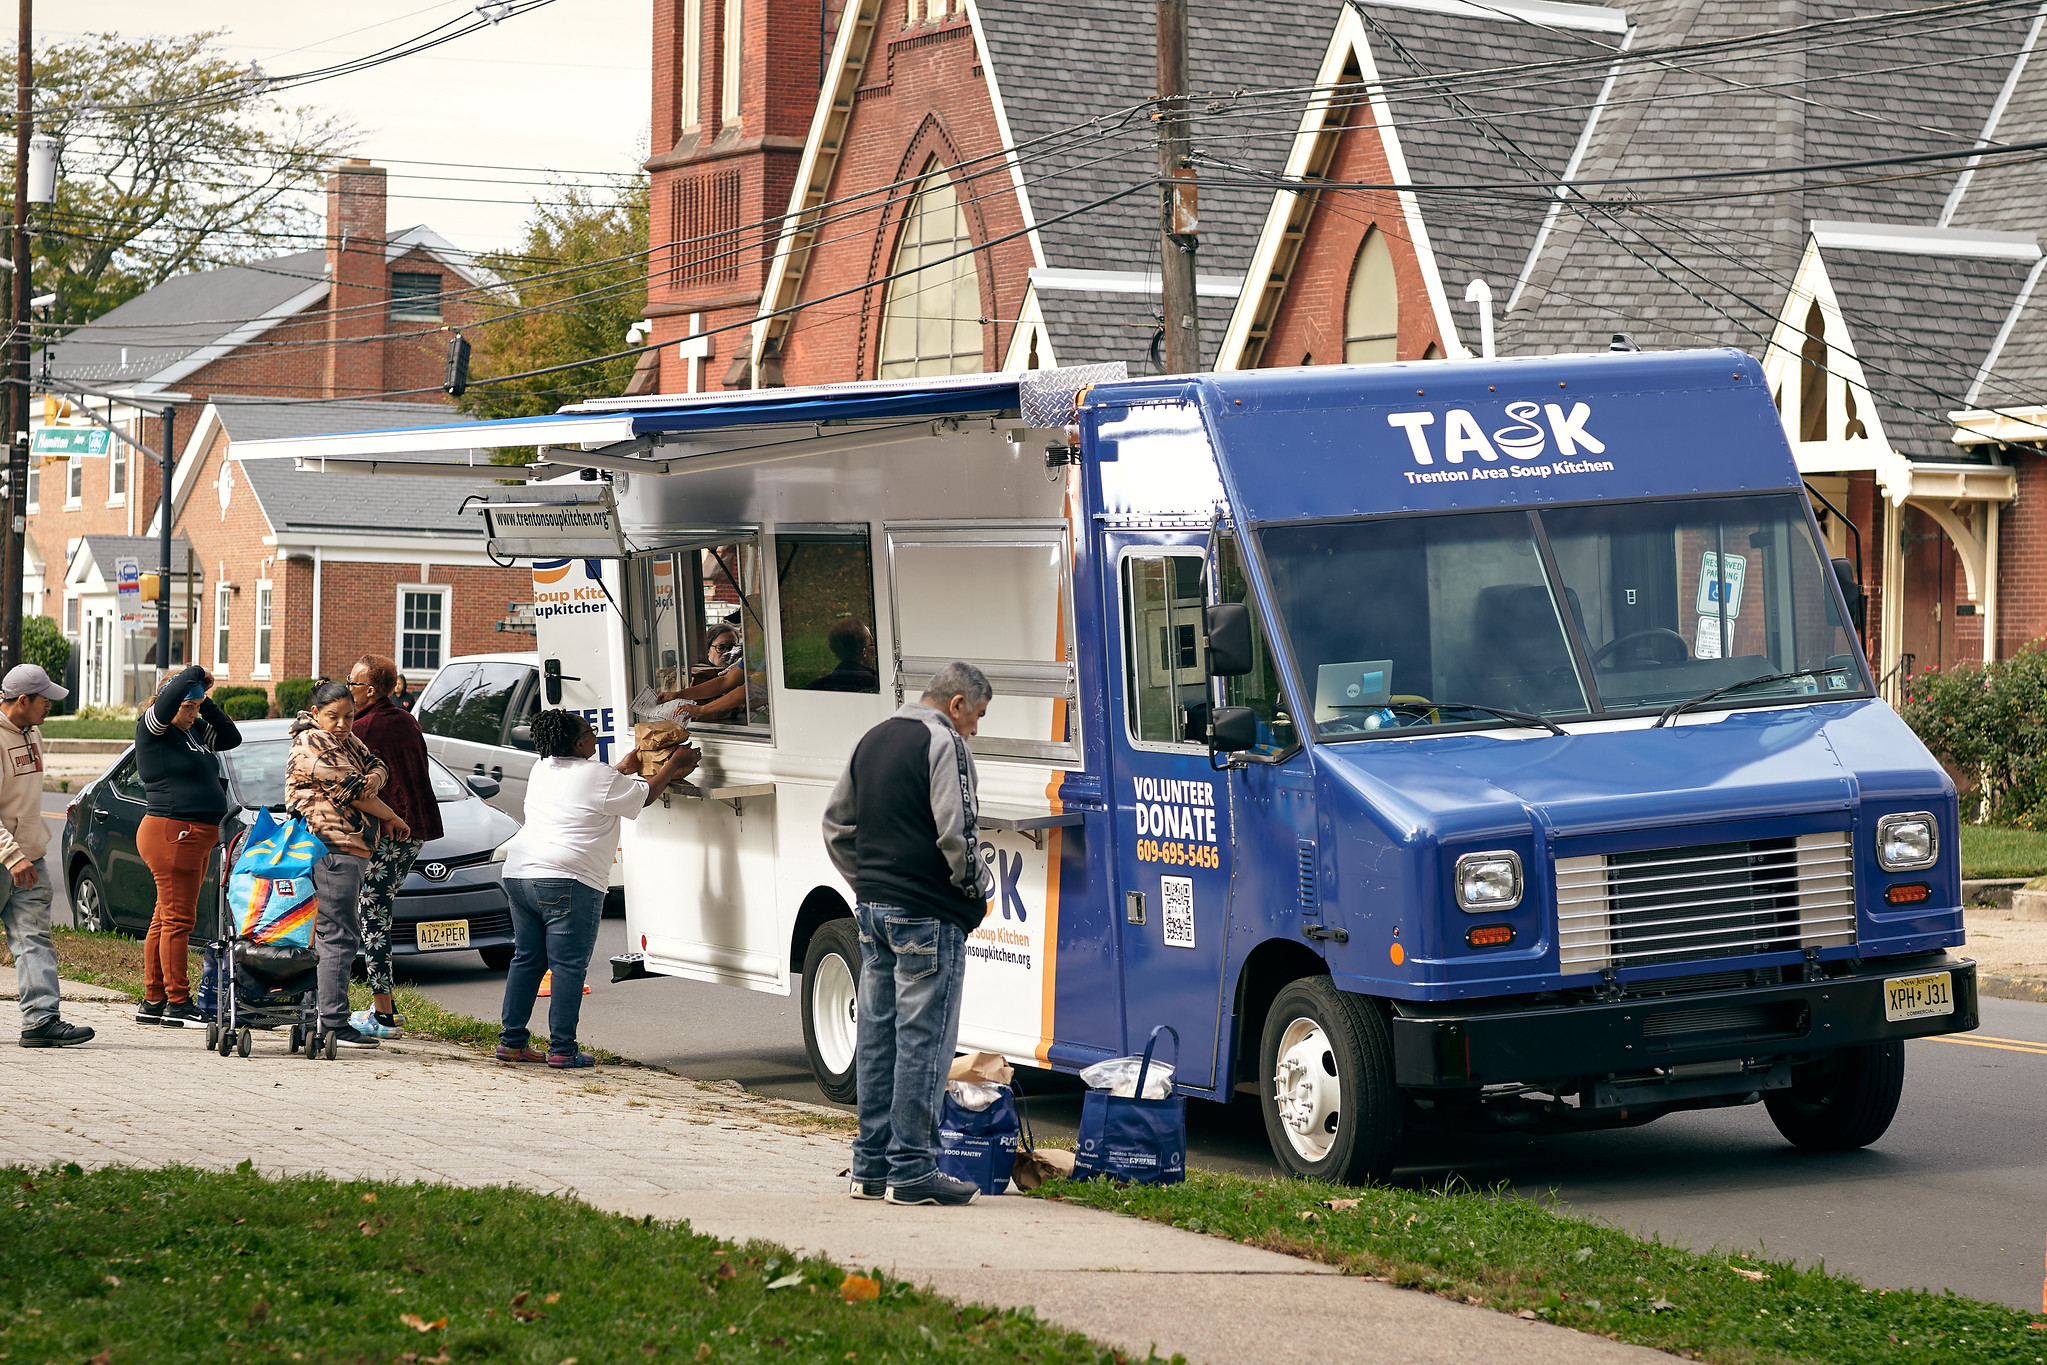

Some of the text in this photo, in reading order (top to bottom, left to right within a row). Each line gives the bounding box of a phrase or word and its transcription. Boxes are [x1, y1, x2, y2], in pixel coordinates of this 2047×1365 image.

[38, 433, 69, 448] Hamilton
[1387, 401, 1606, 465] TASK
[1404, 460, 1614, 484] Trenton Area Soup Kitchen
[495, 509, 609, 531] www.trentonsoupkitchen.org
[1705, 559, 1742, 570] RESRVED
[1706, 569, 1738, 580] PARING
[15, 754, 32, 767] PUM
[1133, 776, 1215, 807] VOLUNTEER
[1136, 802, 1217, 842] DONATE
[1137, 838, 1219, 869] 609-695-5456
[421, 927, 466, 943] A12 PER
[976, 927, 1030, 947] Soup Kitchen
[1900, 977, 1934, 987] New Jersey
[1889, 982, 1949, 1011] XPH J31
[1906, 1008, 1935, 1017] COMMERCIAL
[961, 1150, 982, 1158] PANTRY
